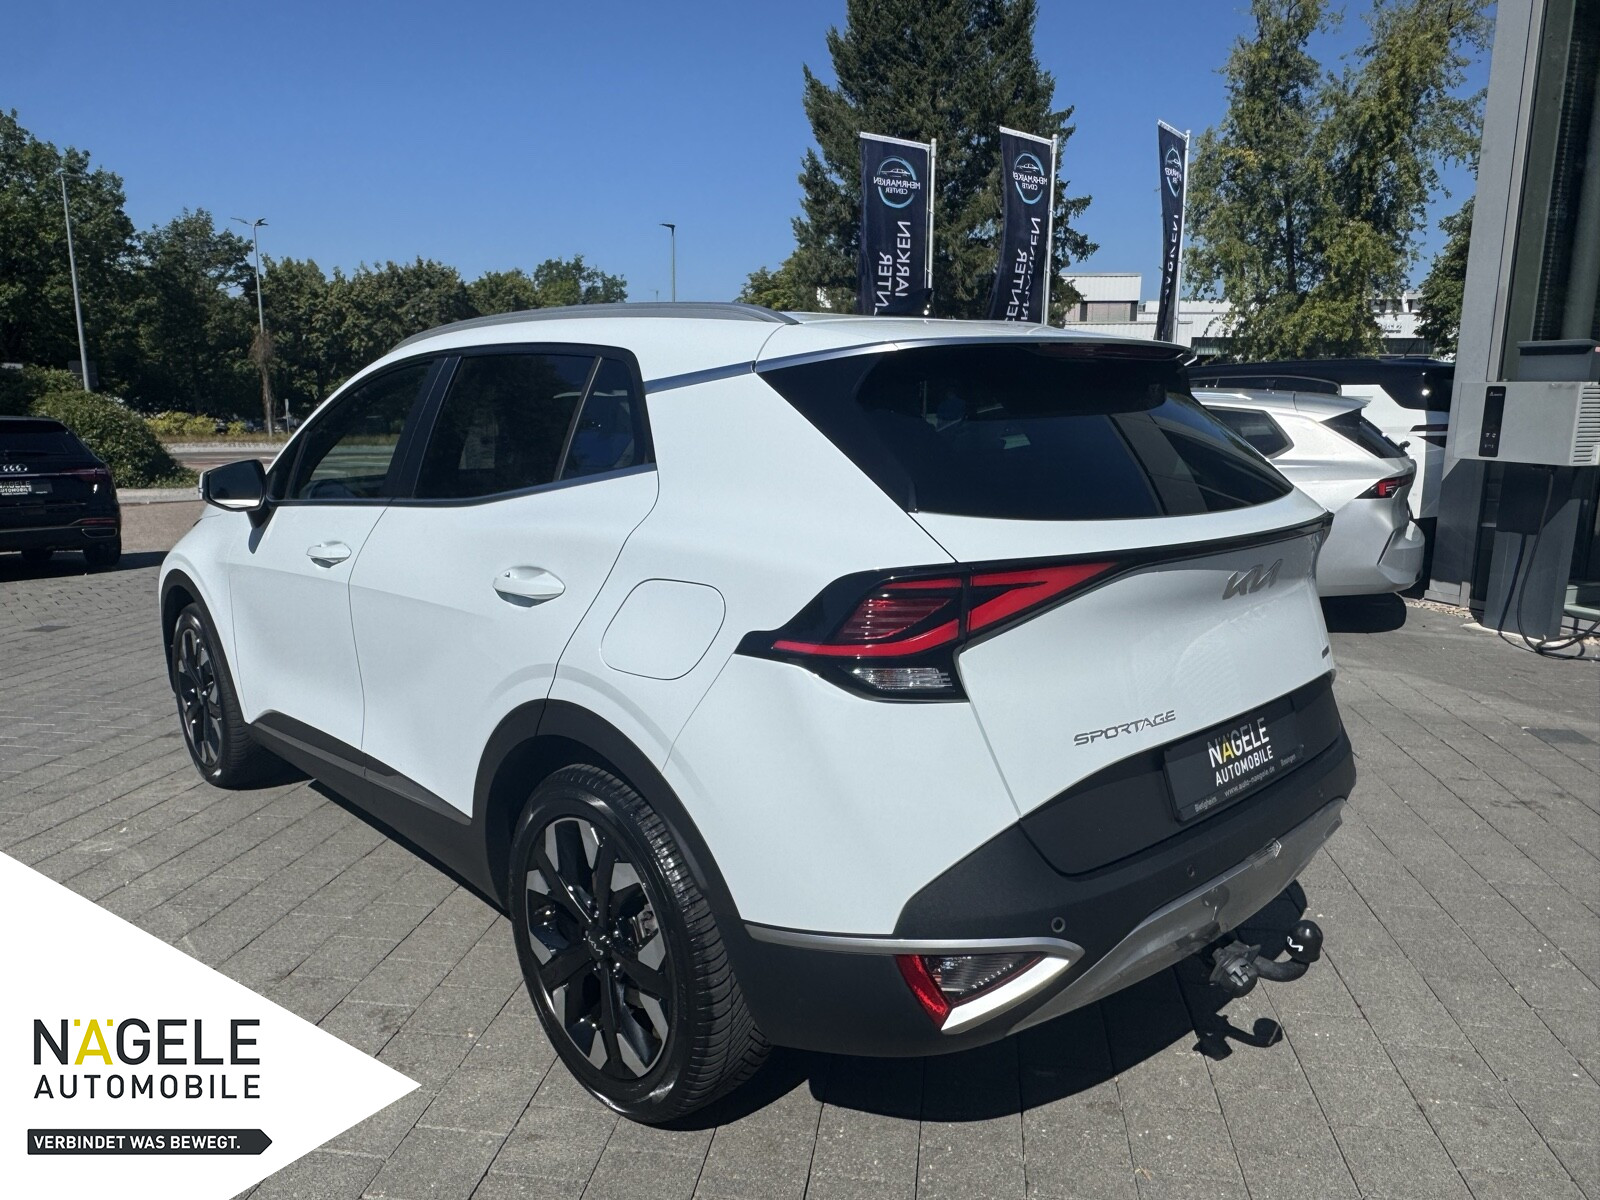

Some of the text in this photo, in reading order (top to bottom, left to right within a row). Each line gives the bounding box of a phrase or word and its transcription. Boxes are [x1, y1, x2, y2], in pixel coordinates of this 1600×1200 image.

[1222, 558, 1283, 600] KIA
[1073, 710, 1176, 746] SPORTAGE
[1207, 717, 1269, 768] NÄGELE
[1215, 745, 1273, 787] AUTOMOBILE
